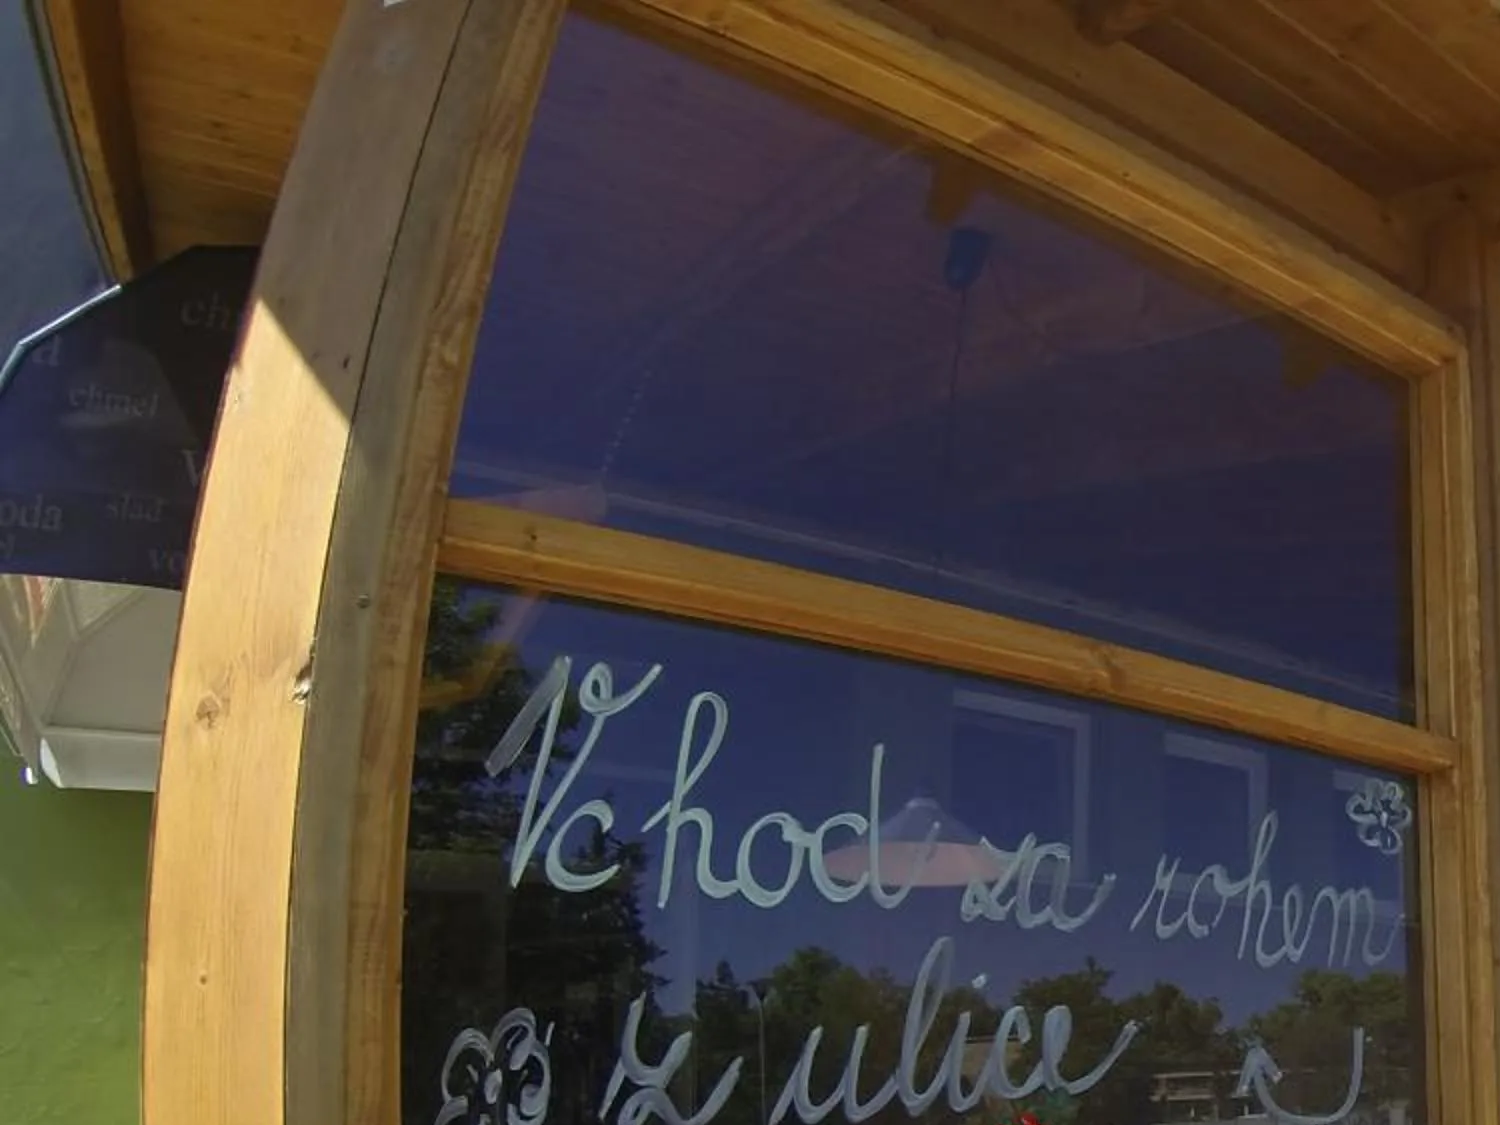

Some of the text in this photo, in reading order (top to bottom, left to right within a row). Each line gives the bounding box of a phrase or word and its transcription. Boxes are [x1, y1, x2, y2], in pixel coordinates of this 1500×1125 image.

[483, 655, 1405, 969] Vchod za rohem
